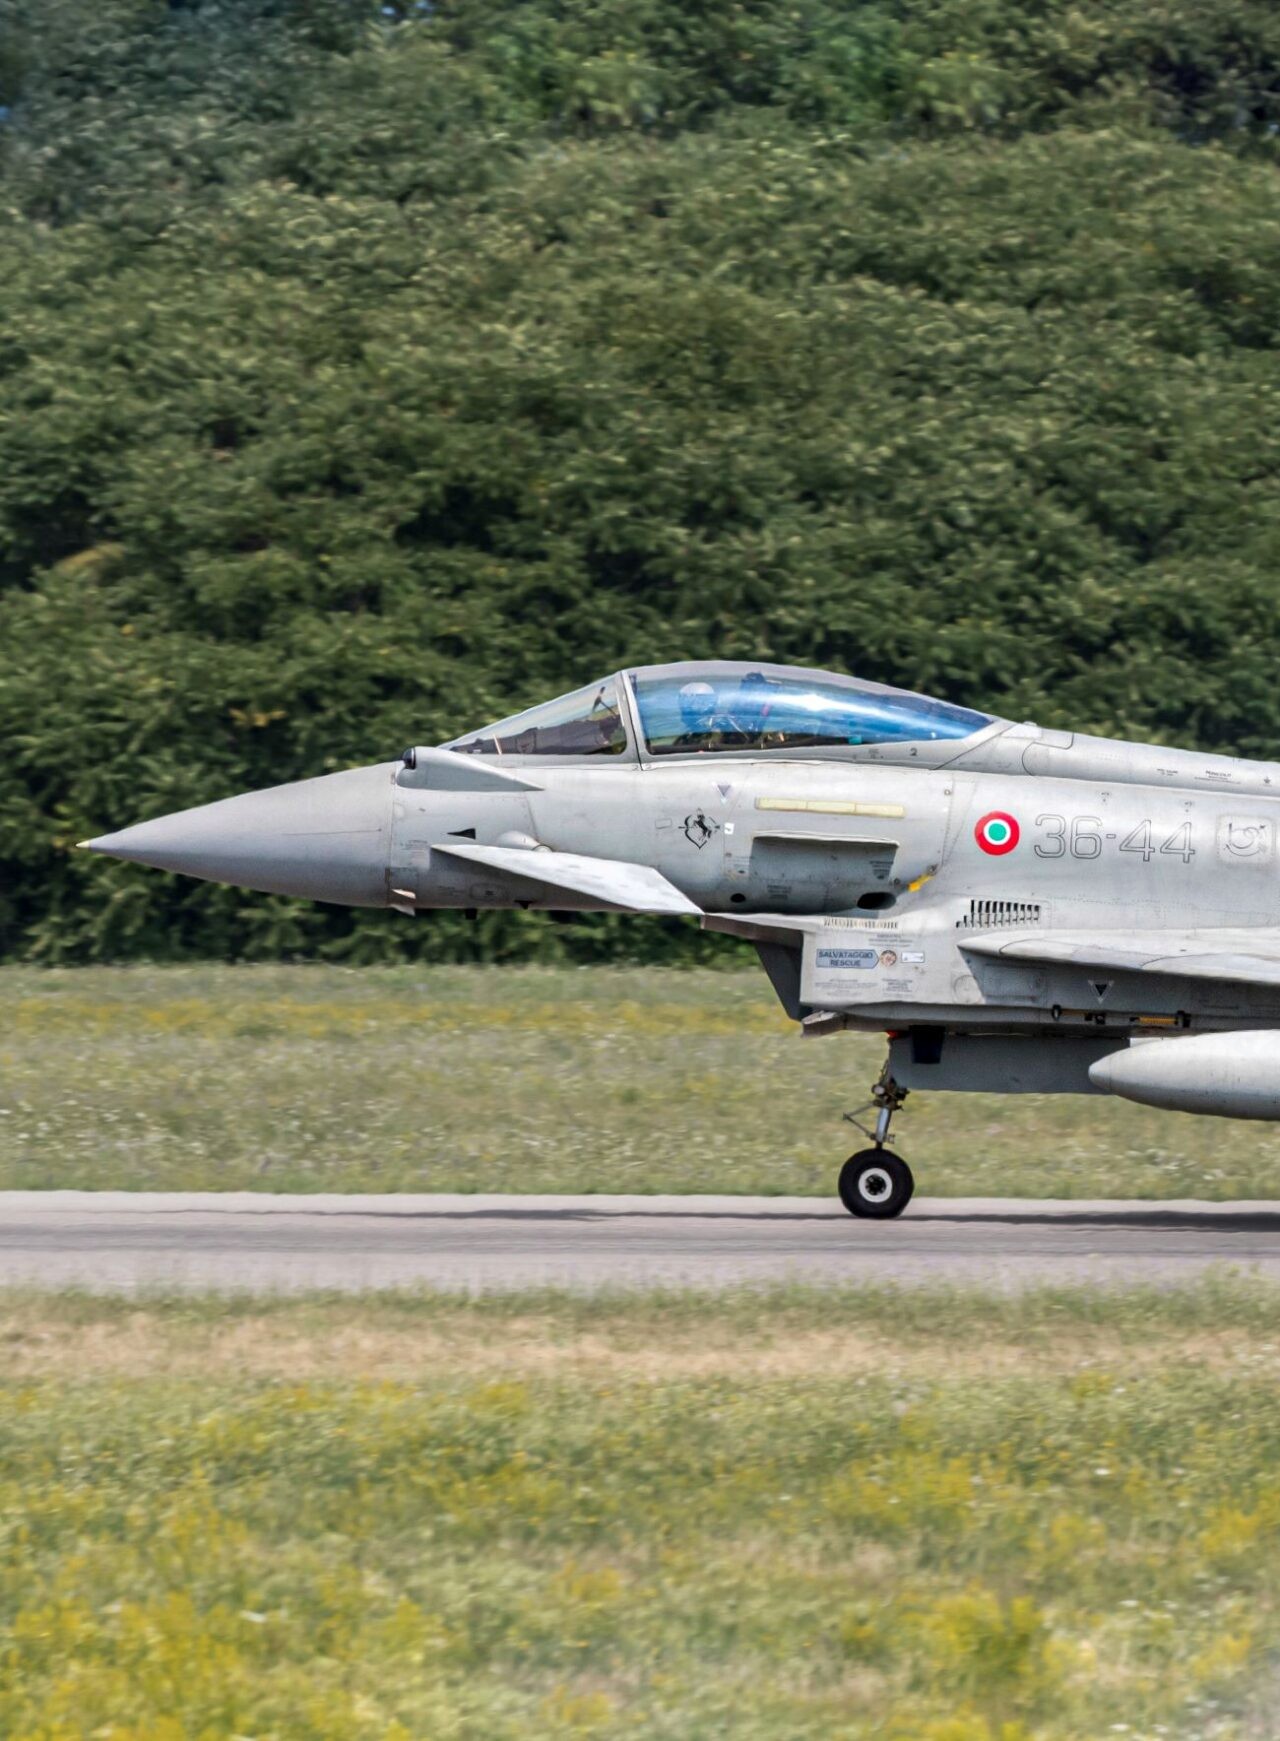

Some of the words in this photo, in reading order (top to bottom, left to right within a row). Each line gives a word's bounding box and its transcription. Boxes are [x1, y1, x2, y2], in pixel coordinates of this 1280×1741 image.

[1034, 813, 1196, 864] 36-44
[818, 951, 874, 959] SALVATAGGIO
[830, 959, 862, 967] RESCUE
